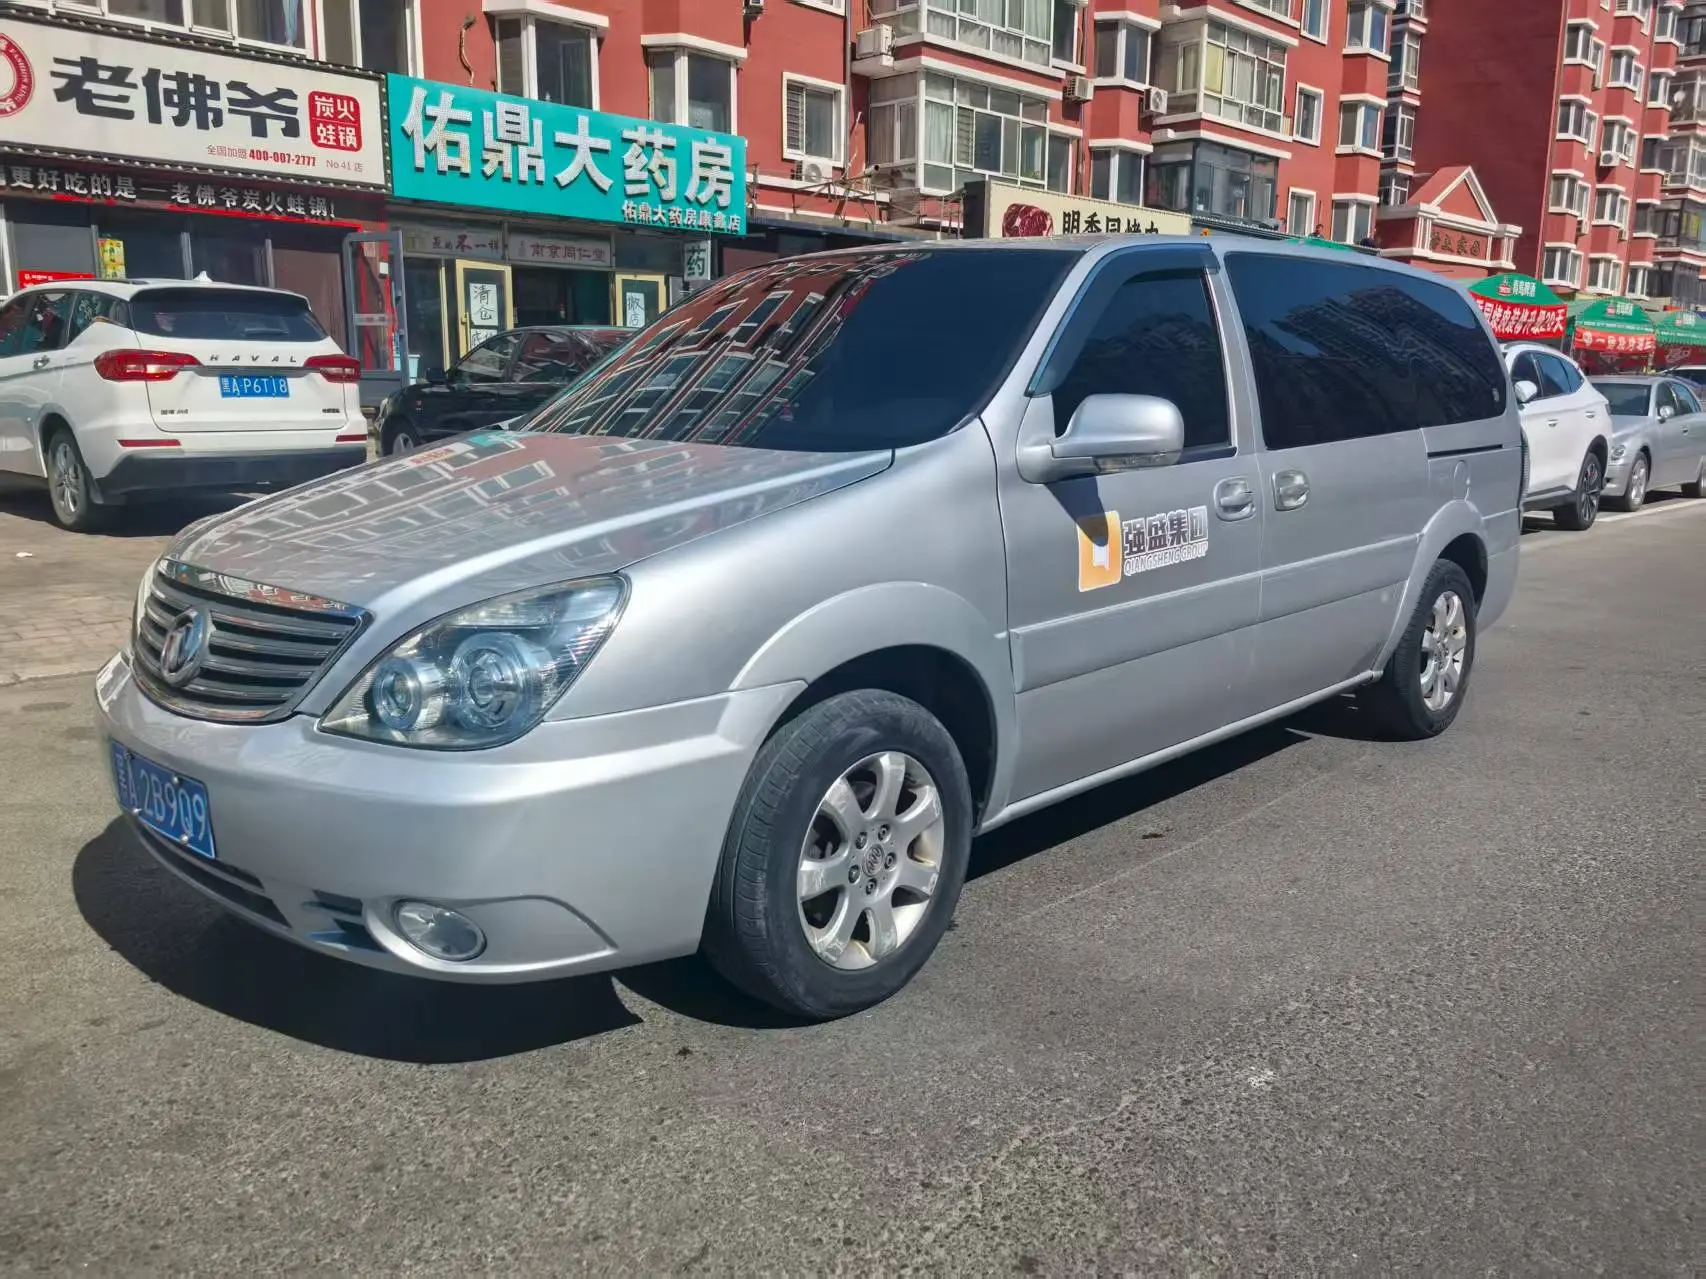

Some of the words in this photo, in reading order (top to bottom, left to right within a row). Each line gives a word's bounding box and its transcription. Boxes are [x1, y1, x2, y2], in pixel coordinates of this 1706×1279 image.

[50, 56, 300, 138] 老佛爷
[314, 95, 356, 121] 炭火
[316, 123, 358, 148] 蛙锅
[401, 86, 735, 207] 佑鼎大药房
[206, 144, 247, 160] 全国加盟
[249, 149, 316, 167] 400-007-2777
[687, 245, 706, 277] 药
[473, 285, 496, 320] 清仓
[210, 355, 297, 363] HAVAL
[1123, 507, 1208, 557] 强盛集团
[1124, 548, 1181, 576] QIANGSHENG
[1181, 541, 1208, 561] GROUP
